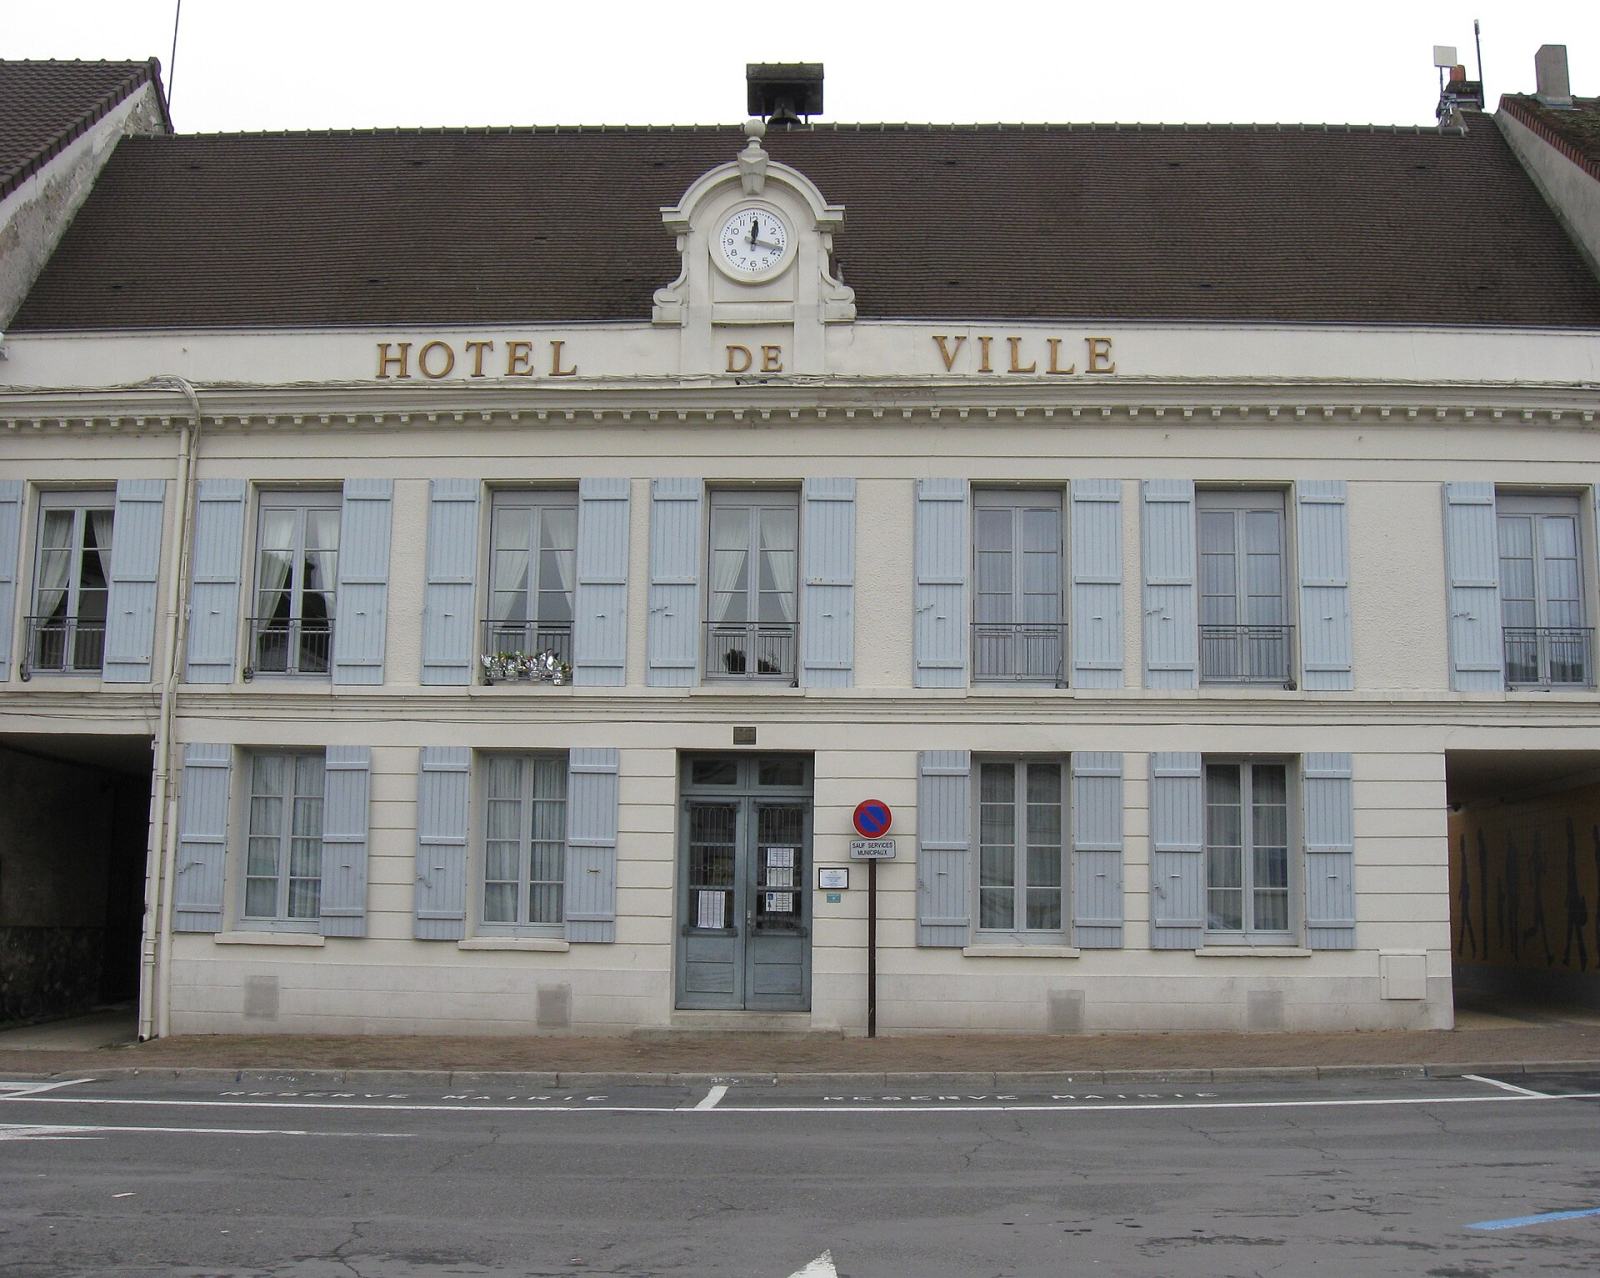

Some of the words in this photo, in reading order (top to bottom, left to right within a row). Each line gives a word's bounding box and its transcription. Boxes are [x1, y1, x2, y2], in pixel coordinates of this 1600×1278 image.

[731, 227, 739, 235] 10
[770, 227, 777, 235] 2
[375, 340, 578, 379] HOTEL
[725, 345, 784, 373] DE
[932, 335, 1116, 375] VILLE
